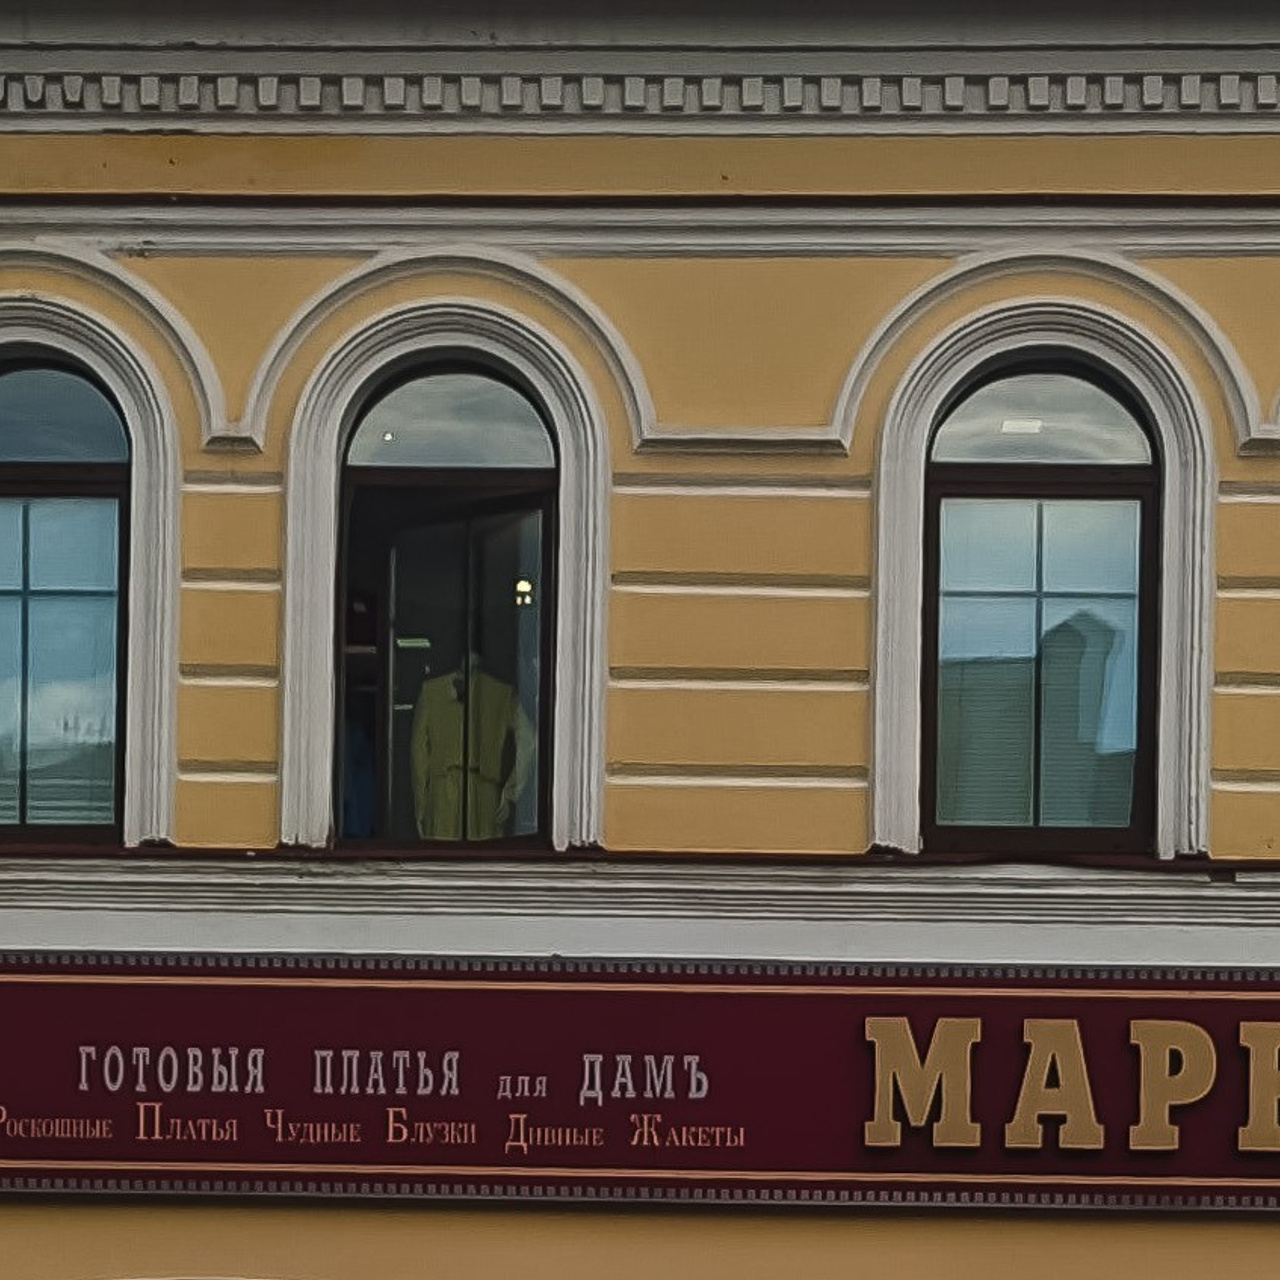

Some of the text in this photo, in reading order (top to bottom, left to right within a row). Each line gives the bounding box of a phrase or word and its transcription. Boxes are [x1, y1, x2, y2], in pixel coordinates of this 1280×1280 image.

[78, 1045, 265, 1094] ГОТОВЫЯ
[313, 1049, 460, 1096] ПЛАТЬЯ
[579, 1053, 709, 1107] ДАМЪ
